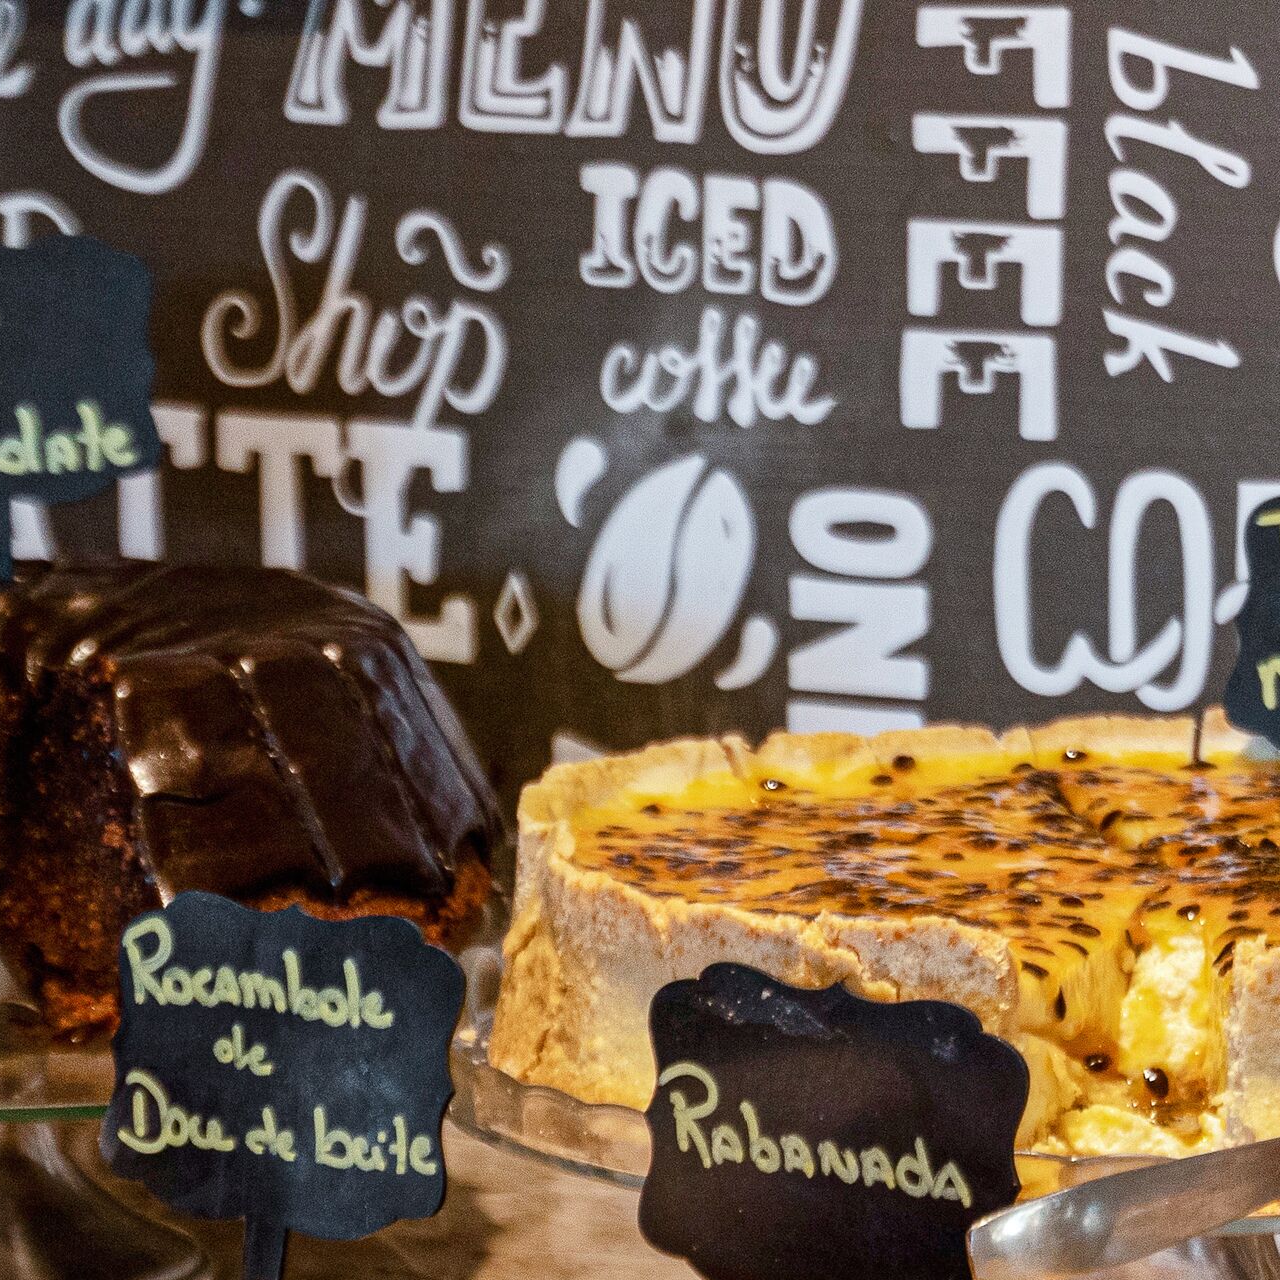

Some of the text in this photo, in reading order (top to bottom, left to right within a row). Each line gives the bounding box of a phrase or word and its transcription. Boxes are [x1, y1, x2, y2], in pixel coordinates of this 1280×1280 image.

[284, 0, 864, 156] MENU
[578, 162, 838, 306] ICED
[1104, 26, 1260, 384] black
[201, 170, 505, 430] Shop
[599, 306, 840, 428] coffee
[121, 915, 396, 1030] Rocambole
[116, 1069, 237, 1155] Doce
[244, 1105, 299, 1163] de
[212, 1023, 275, 1077] de
[657, 1060, 973, 1209] Rabanada
